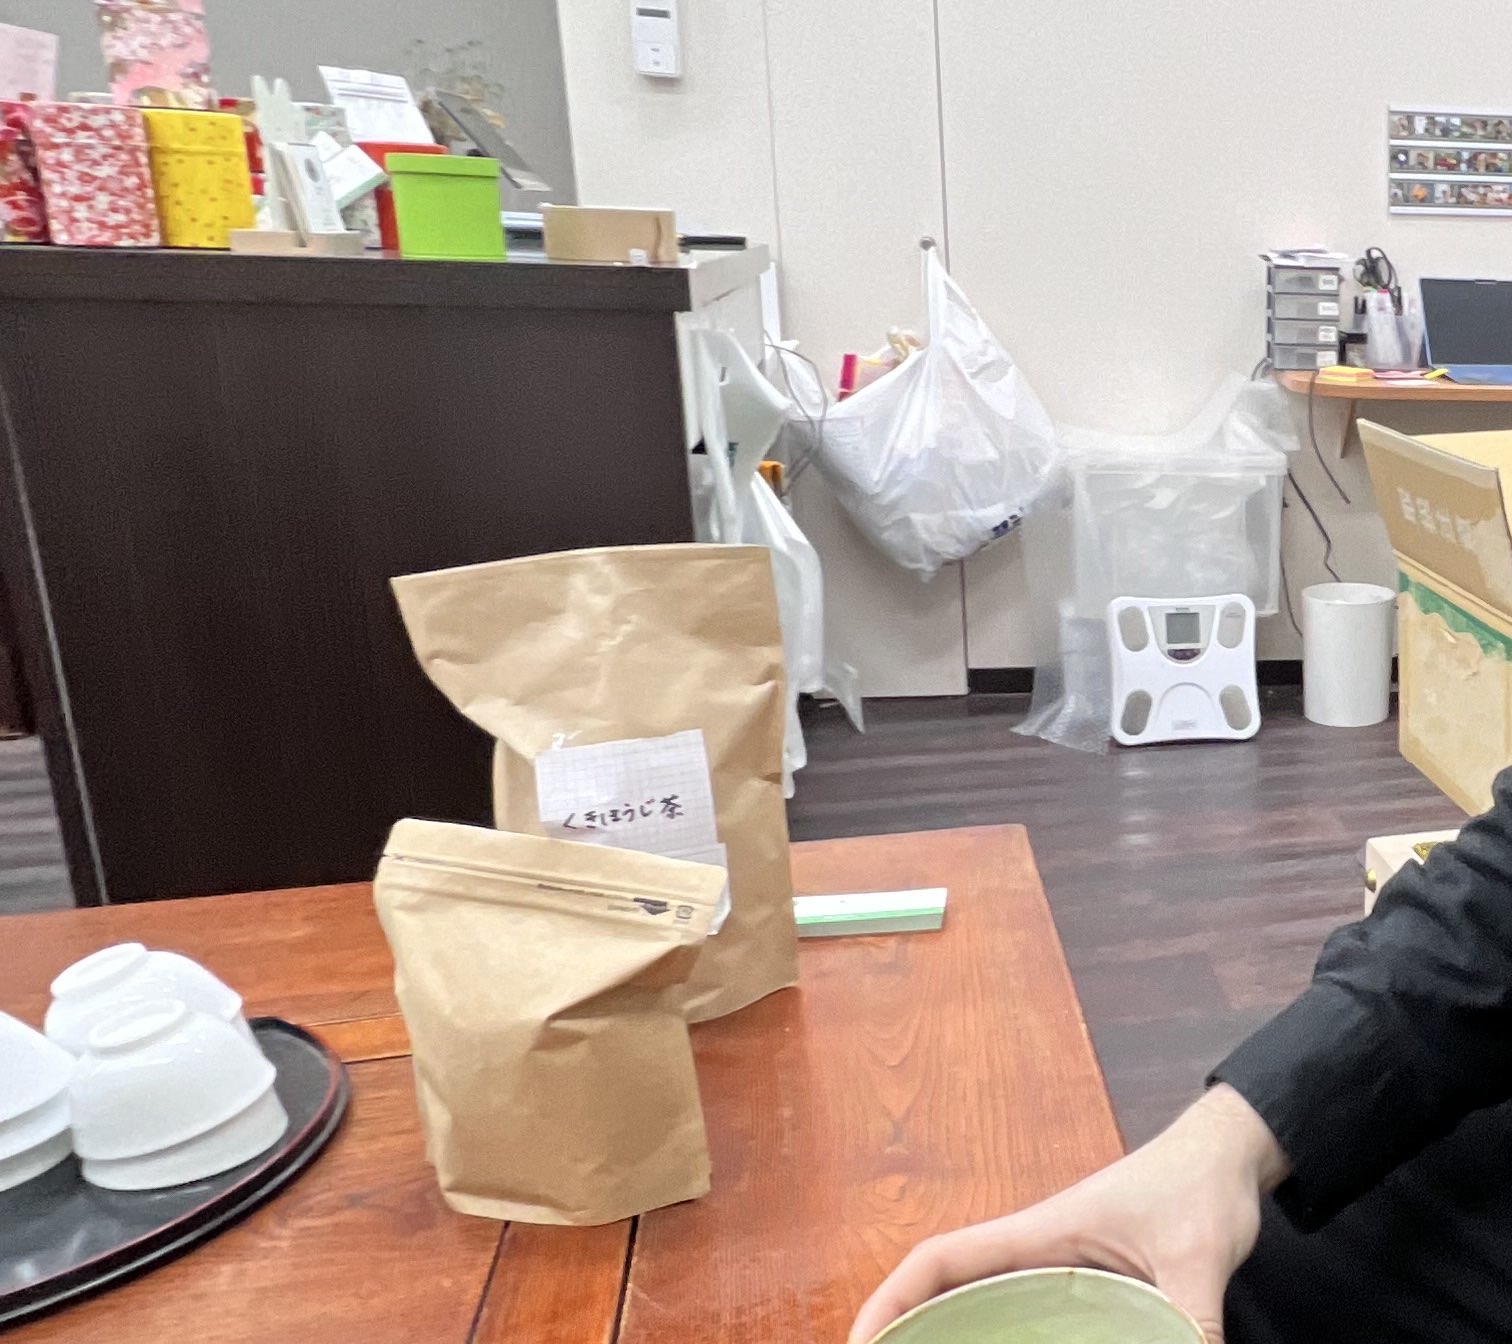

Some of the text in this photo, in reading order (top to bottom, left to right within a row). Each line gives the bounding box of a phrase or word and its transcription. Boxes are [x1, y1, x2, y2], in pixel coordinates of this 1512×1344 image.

[563, 794, 684, 829] くきほうじ茶
